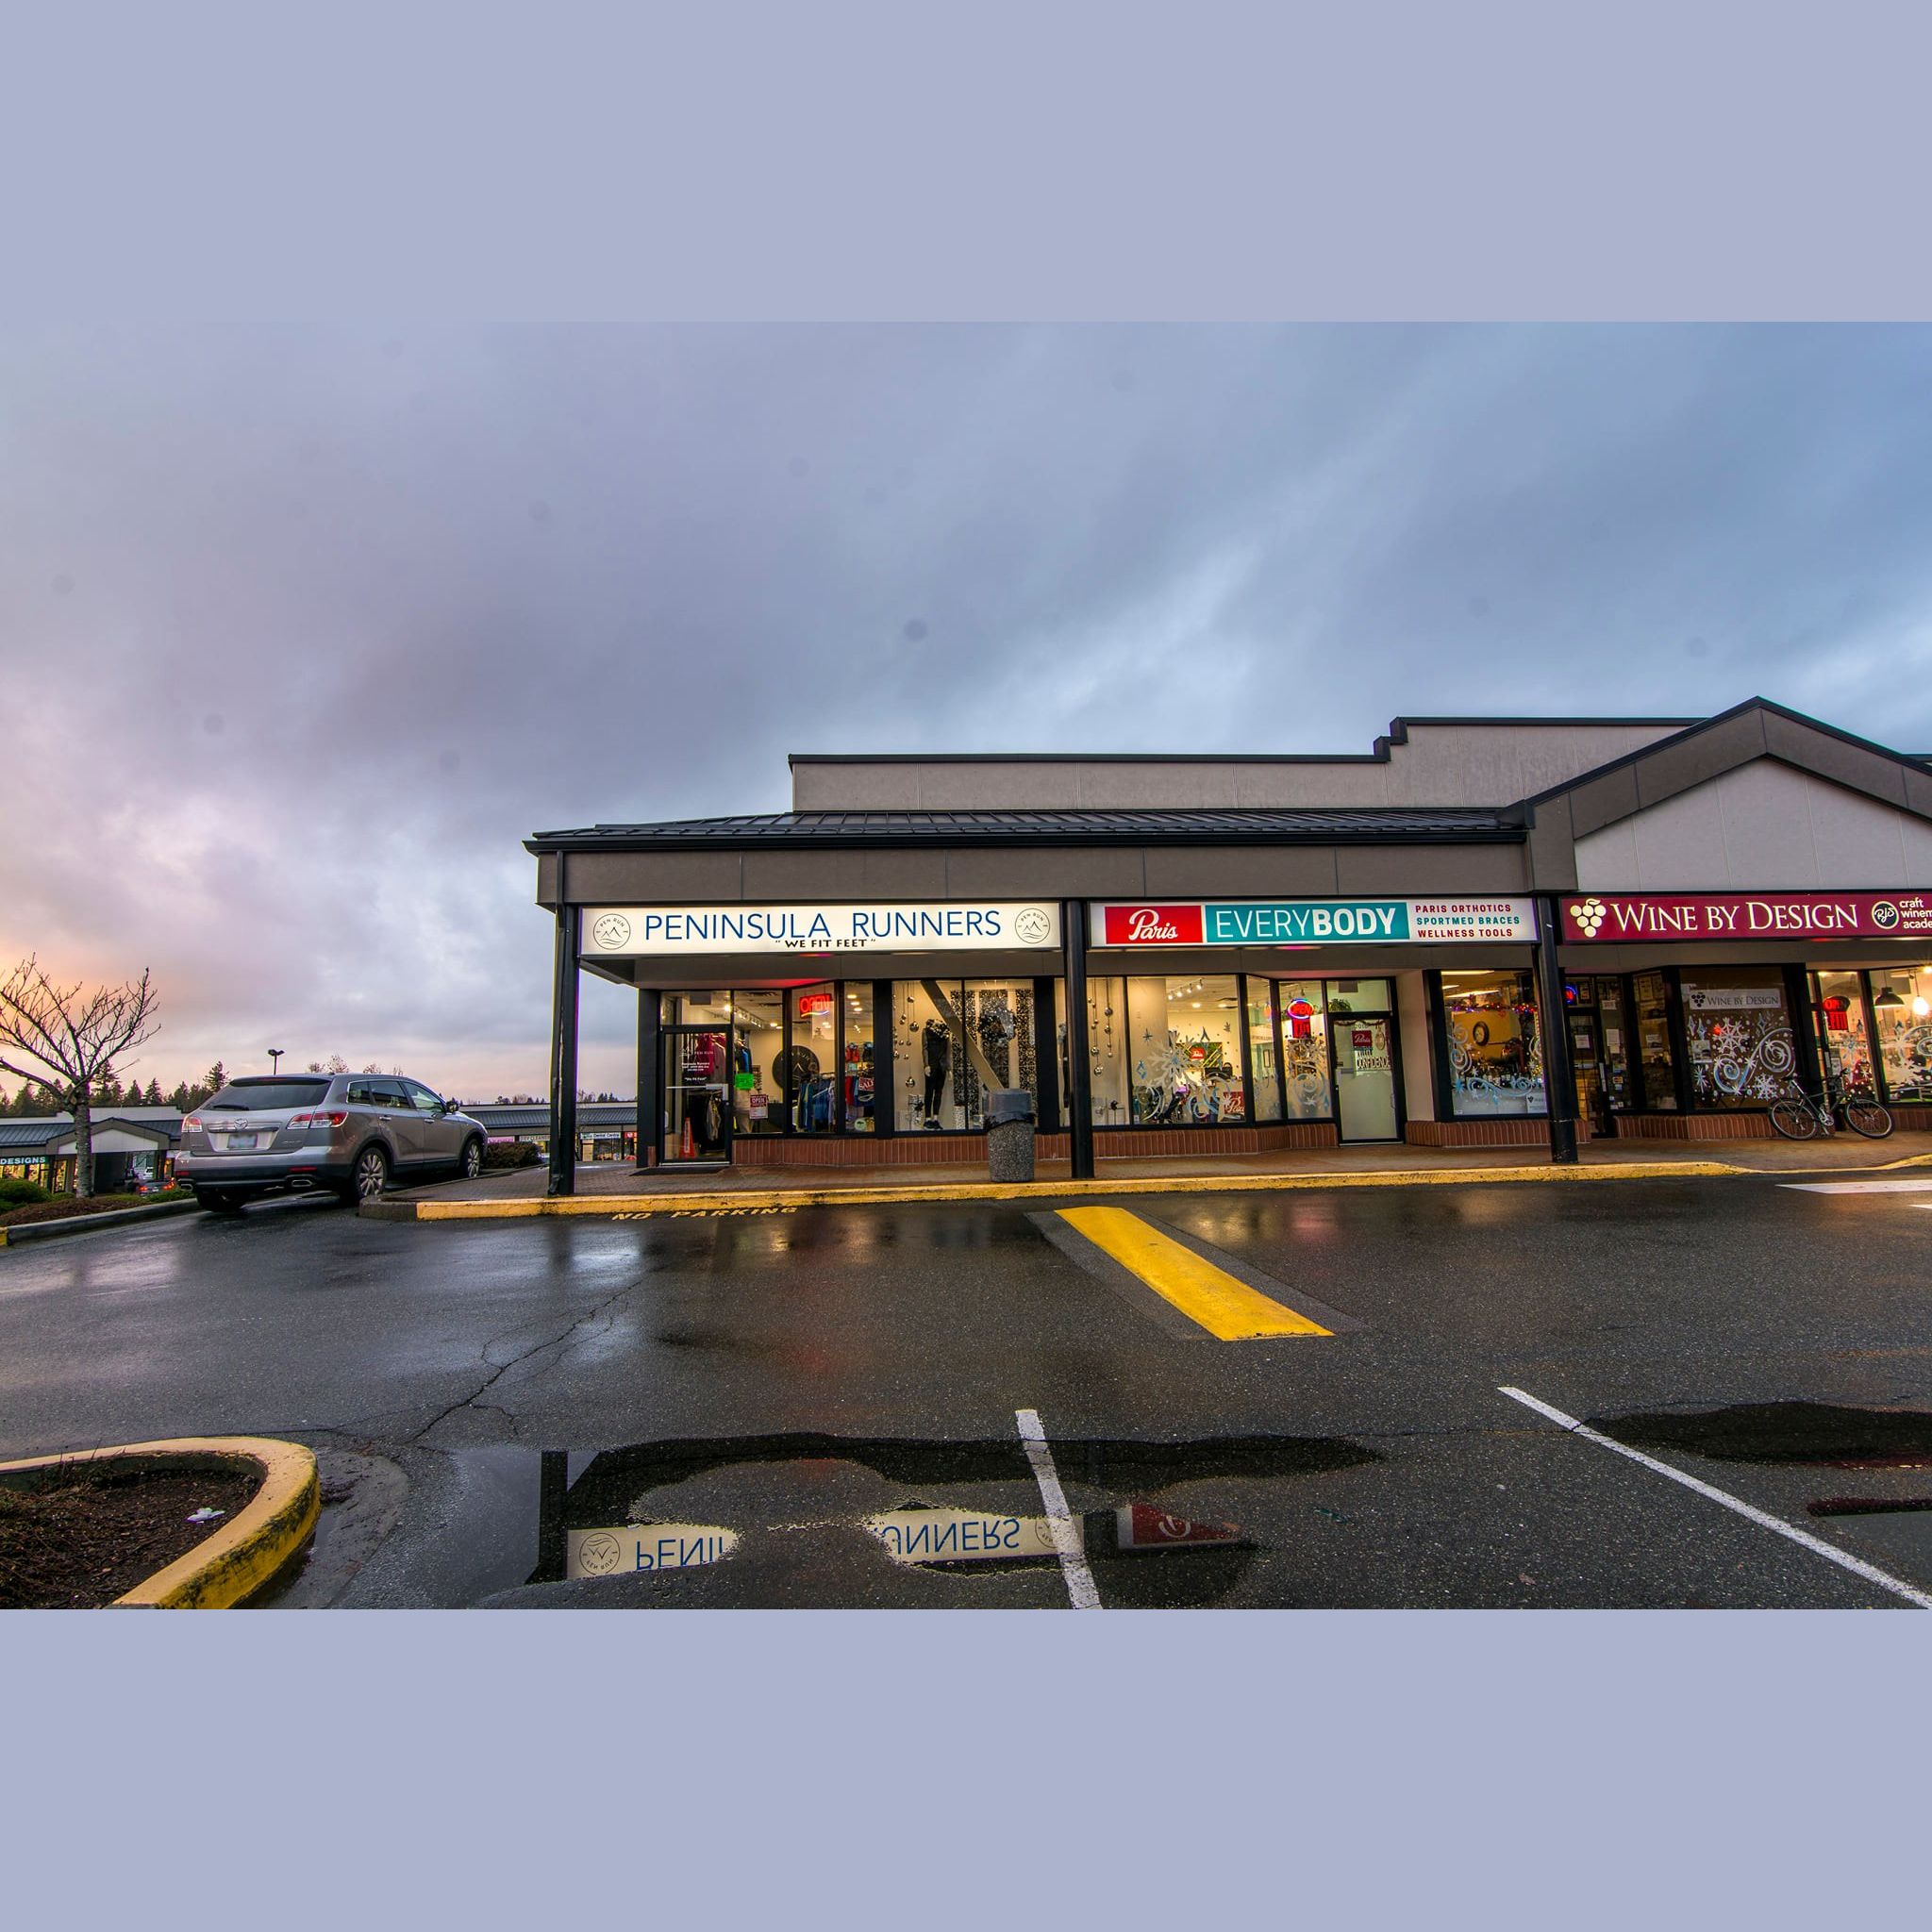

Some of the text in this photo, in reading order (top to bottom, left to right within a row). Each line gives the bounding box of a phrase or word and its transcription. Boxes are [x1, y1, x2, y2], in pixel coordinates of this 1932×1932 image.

[1899, 897, 1924, 908] craft
[1415, 904, 1511, 913] PARIS ORTHOTICS
[1020, 911, 1045, 922] PEN RUN
[1416, 916, 1521, 925] SPORTMED BRACES
[1609, 902, 1858, 932] WINE BY DESIGN
[599, 918, 625, 928] PEN RUN
[645, 910, 1001, 941] PENINSULA RUNNERS
[1128, 908, 1178, 941] Paris
[1216, 908, 1396, 938] EVERYBODY
[1418, 928, 1513, 938] WELLNESS TOOLS
[811, 940, 832, 948] FIT
[800, 995, 831, 1013] OPEN
[0, 1157, 46, 1165] DESIGNS
[671, 1207, 798, 1218] PARKING
